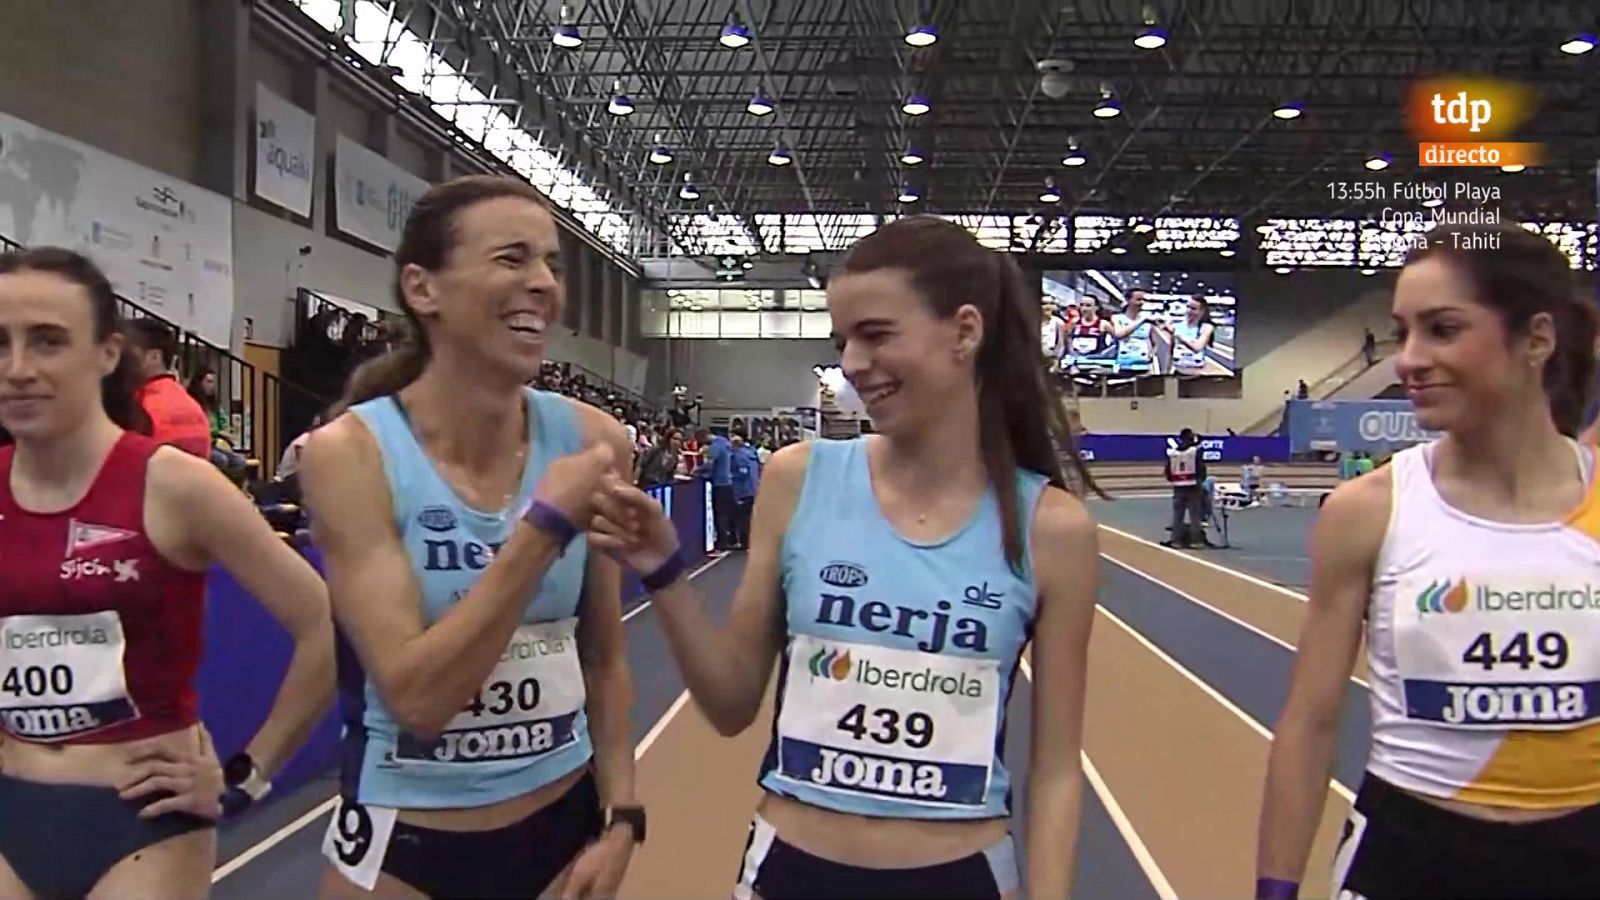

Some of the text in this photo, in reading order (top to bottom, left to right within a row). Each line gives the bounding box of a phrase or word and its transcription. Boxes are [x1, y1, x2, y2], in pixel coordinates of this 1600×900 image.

[822, 565, 867, 586] TROPS
[815, 593, 989, 653] nerja
[1462, 631, 1569, 670] 449
[2, 664, 74, 697] 400
[857, 660, 983, 698] Iberdrola
[837, 703, 934, 749] 439
[335, 801, 373, 867] 9
